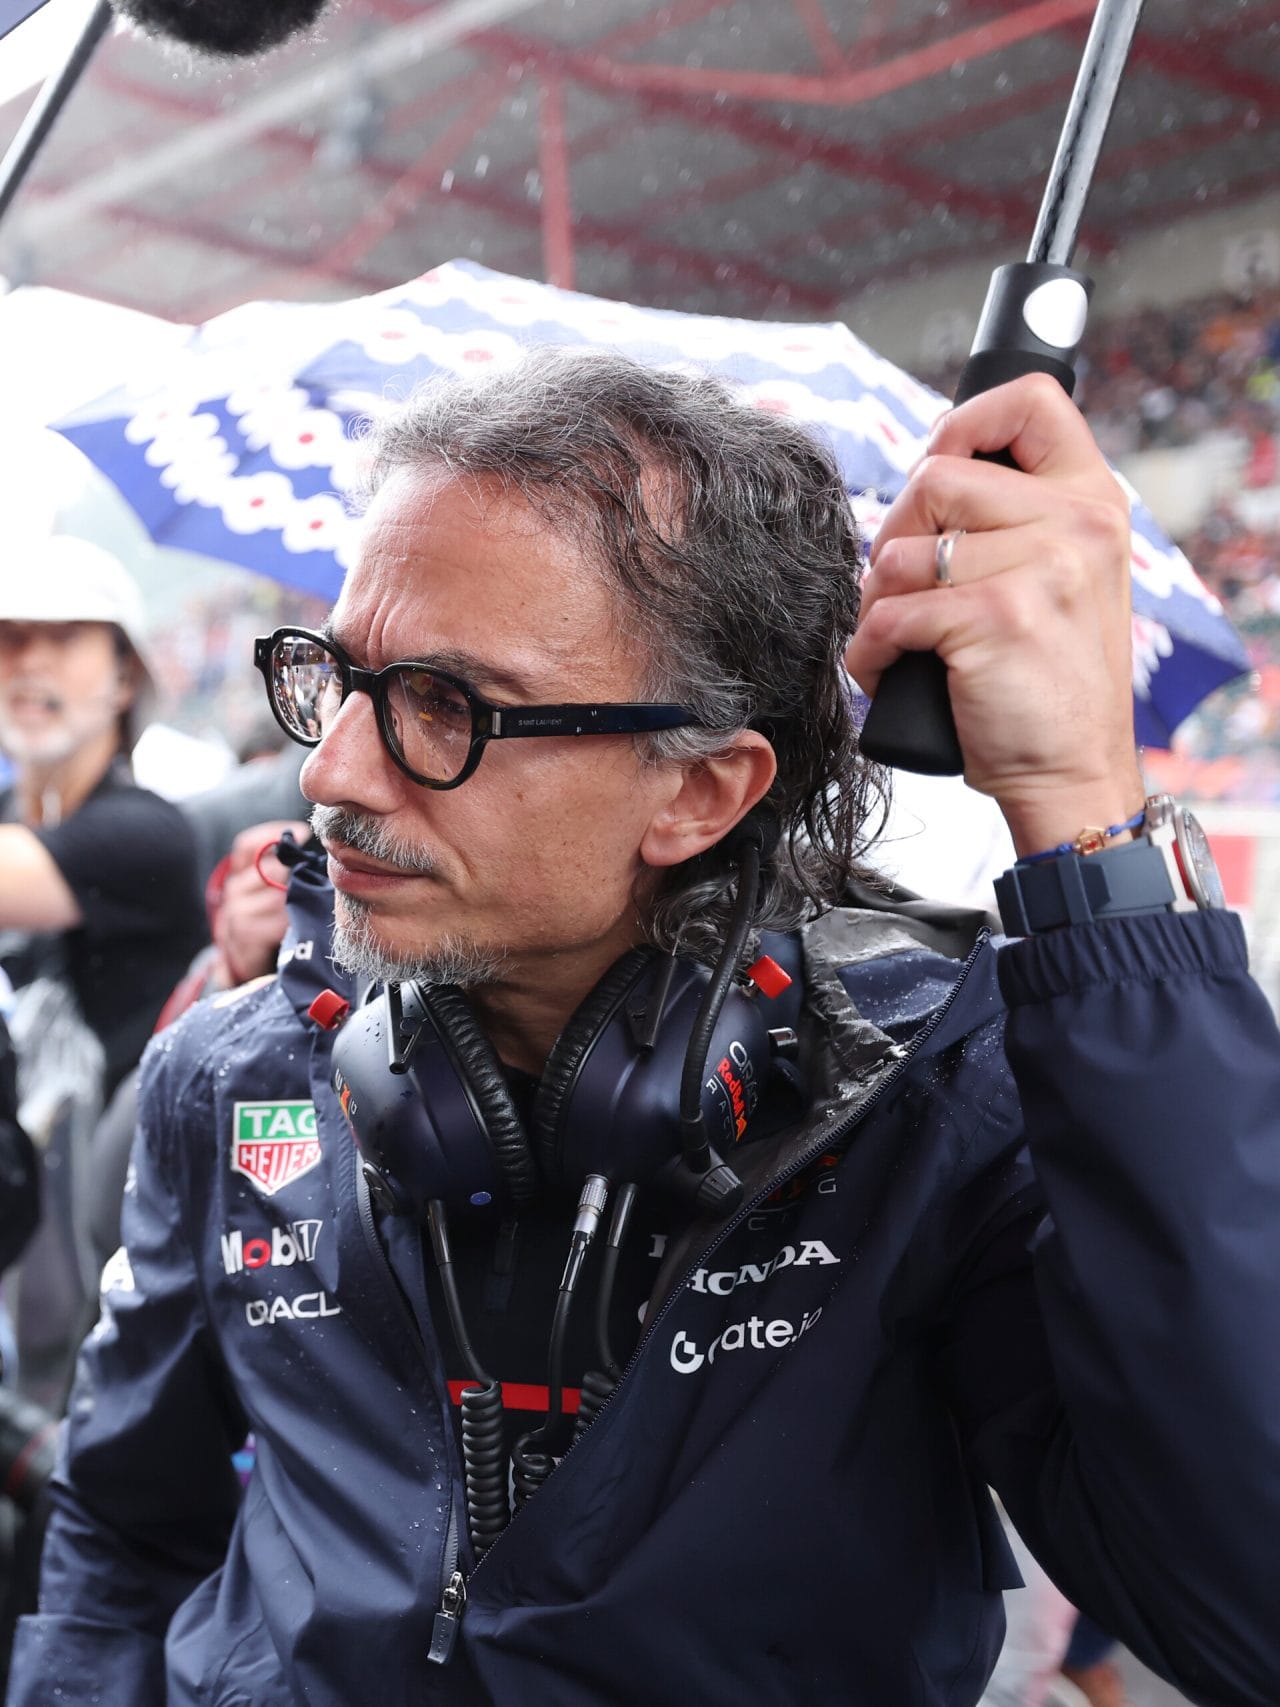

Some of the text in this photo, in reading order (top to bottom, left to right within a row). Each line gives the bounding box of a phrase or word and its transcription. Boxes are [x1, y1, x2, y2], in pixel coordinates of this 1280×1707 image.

[242, 1107, 319, 1138] TAG
[240, 1143, 320, 1188] HEUER
[221, 1226, 305, 1275] Mobi
[245, 1290, 343, 1328] ORACL
